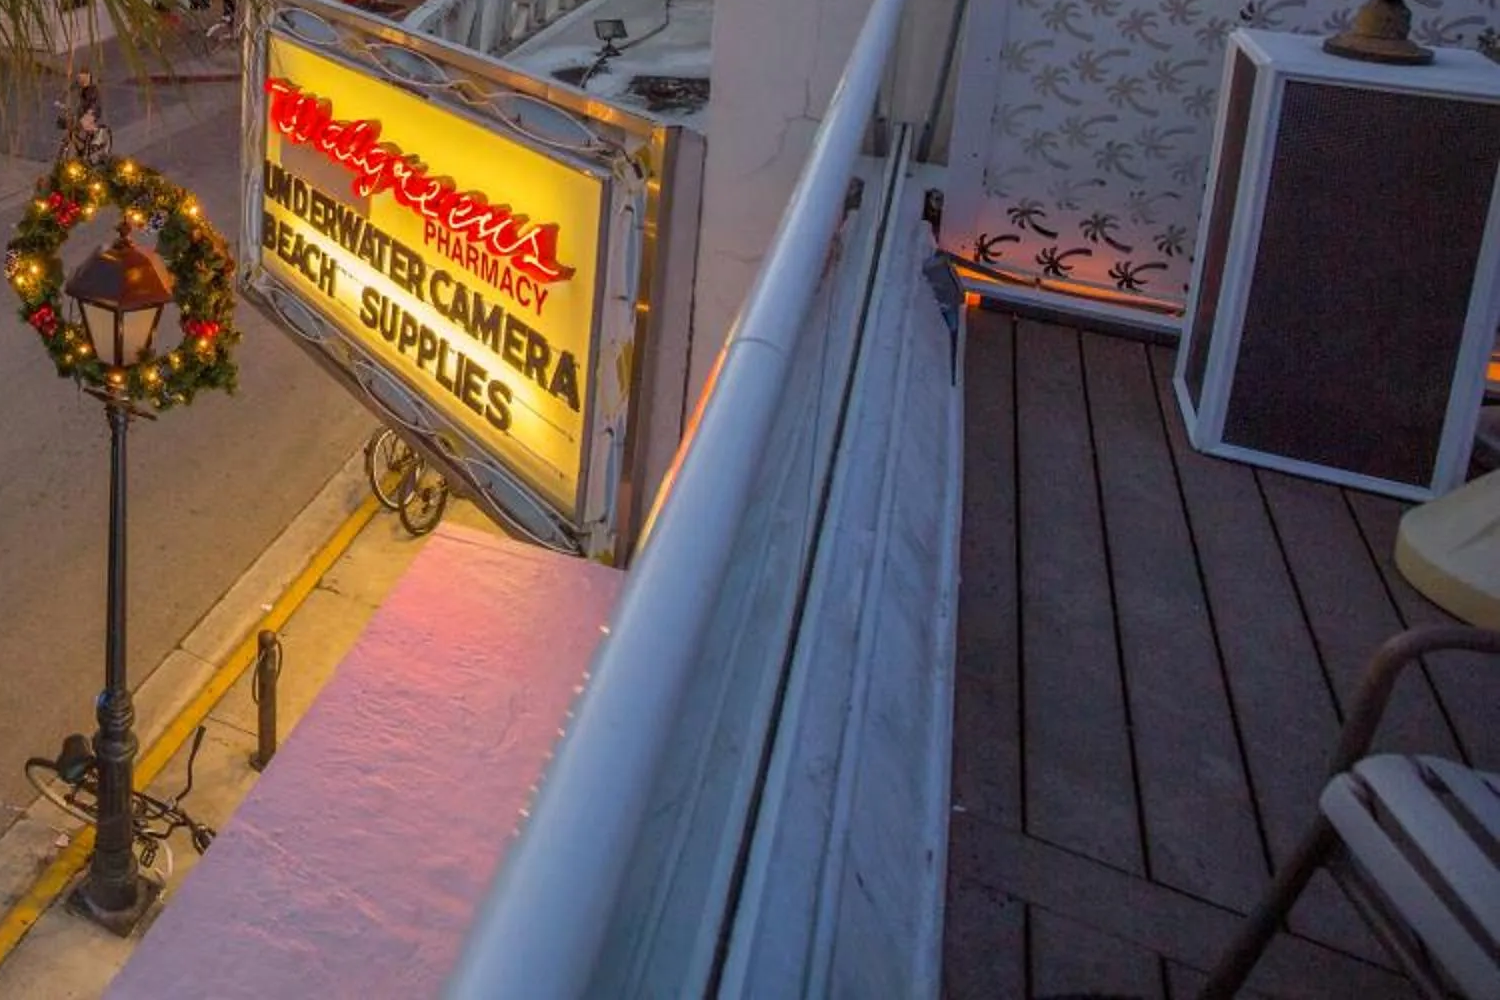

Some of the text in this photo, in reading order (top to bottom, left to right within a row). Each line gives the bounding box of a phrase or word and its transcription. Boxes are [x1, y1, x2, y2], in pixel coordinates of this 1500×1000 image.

[264, 77, 576, 282] Walgreens
[265, 159, 581, 413] UNDERWATER CAMERA
[424, 220, 549, 317] PHARMACY
[263, 211, 513, 432] BEACH SUPPLIES
